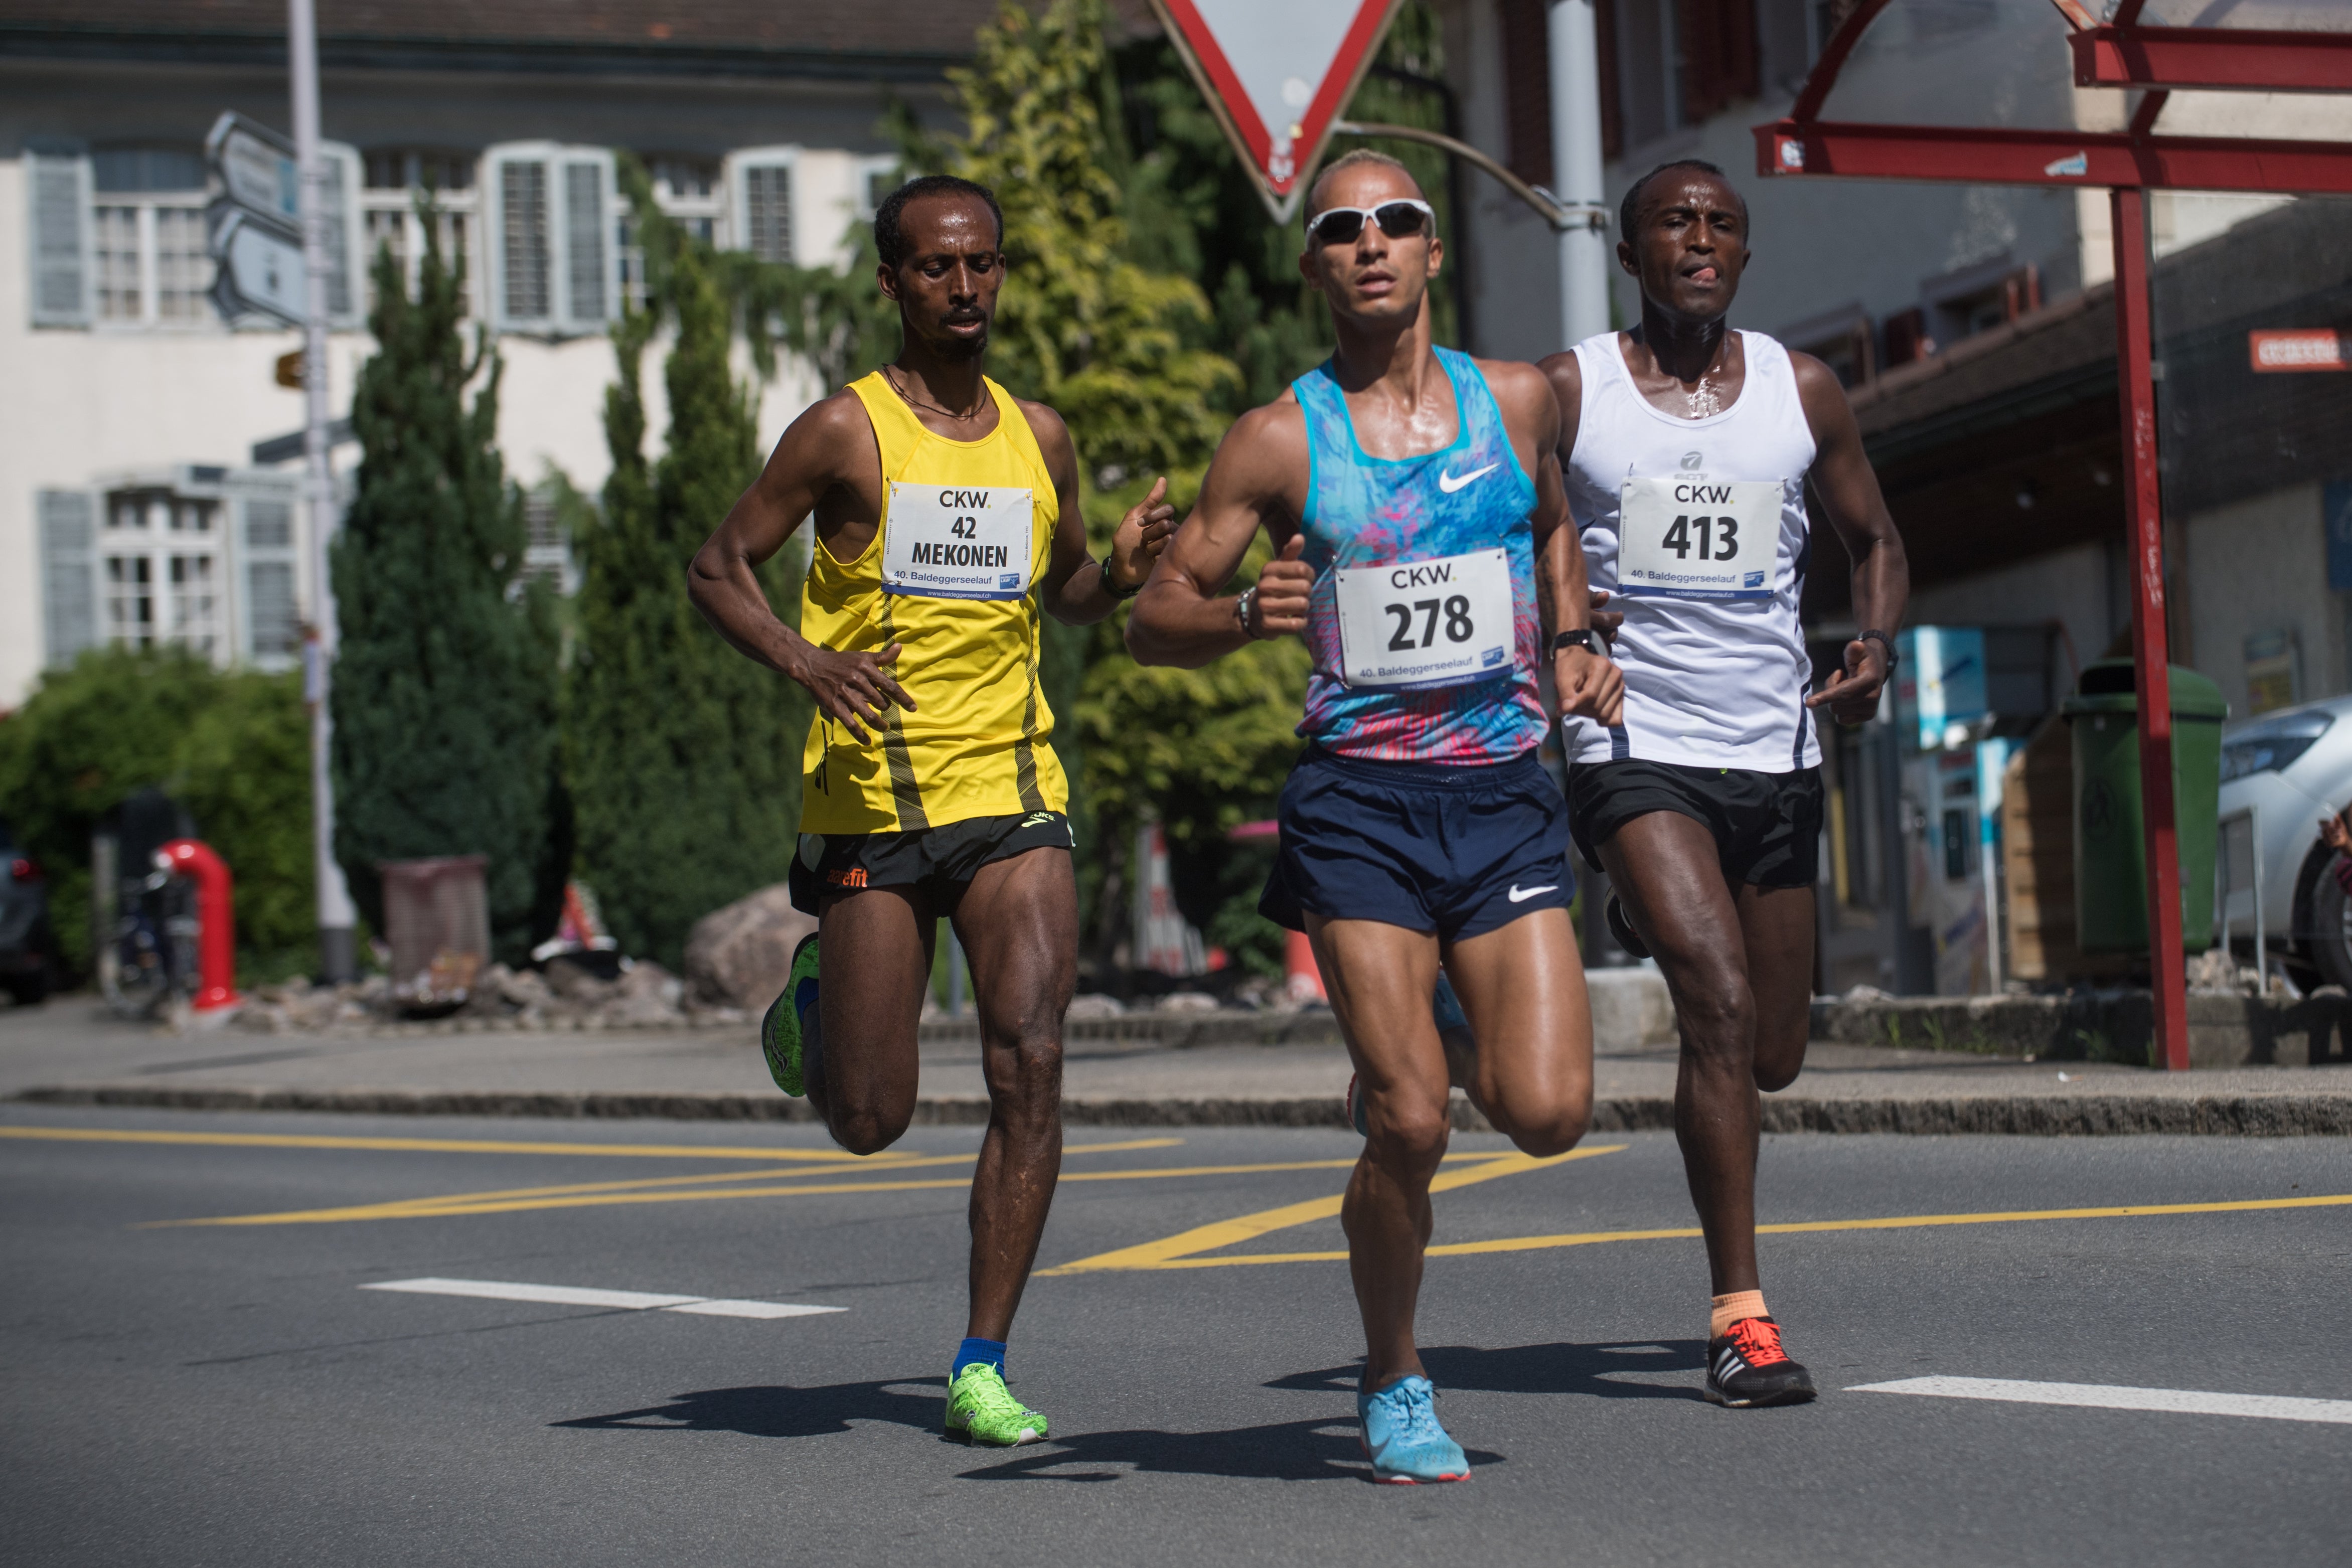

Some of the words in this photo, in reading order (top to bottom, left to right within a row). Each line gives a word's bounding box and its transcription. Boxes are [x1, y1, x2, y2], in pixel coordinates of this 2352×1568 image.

[951, 516, 976, 539] 42
[1662, 515, 1739, 561] 413
[911, 542, 1007, 567] MEKONEN
[894, 570, 908, 579] 40.
[911, 572, 992, 584] Baldeggerseelauf
[1631, 570, 1645, 578] 40.
[1648, 571, 1736, 583] Baldeggerseelauf
[1384, 595, 1473, 652] 278
[1360, 669, 1375, 678] 40.
[1378, 657, 1473, 677] Baldeggerseelauf
[827, 868, 867, 887] aarefit
